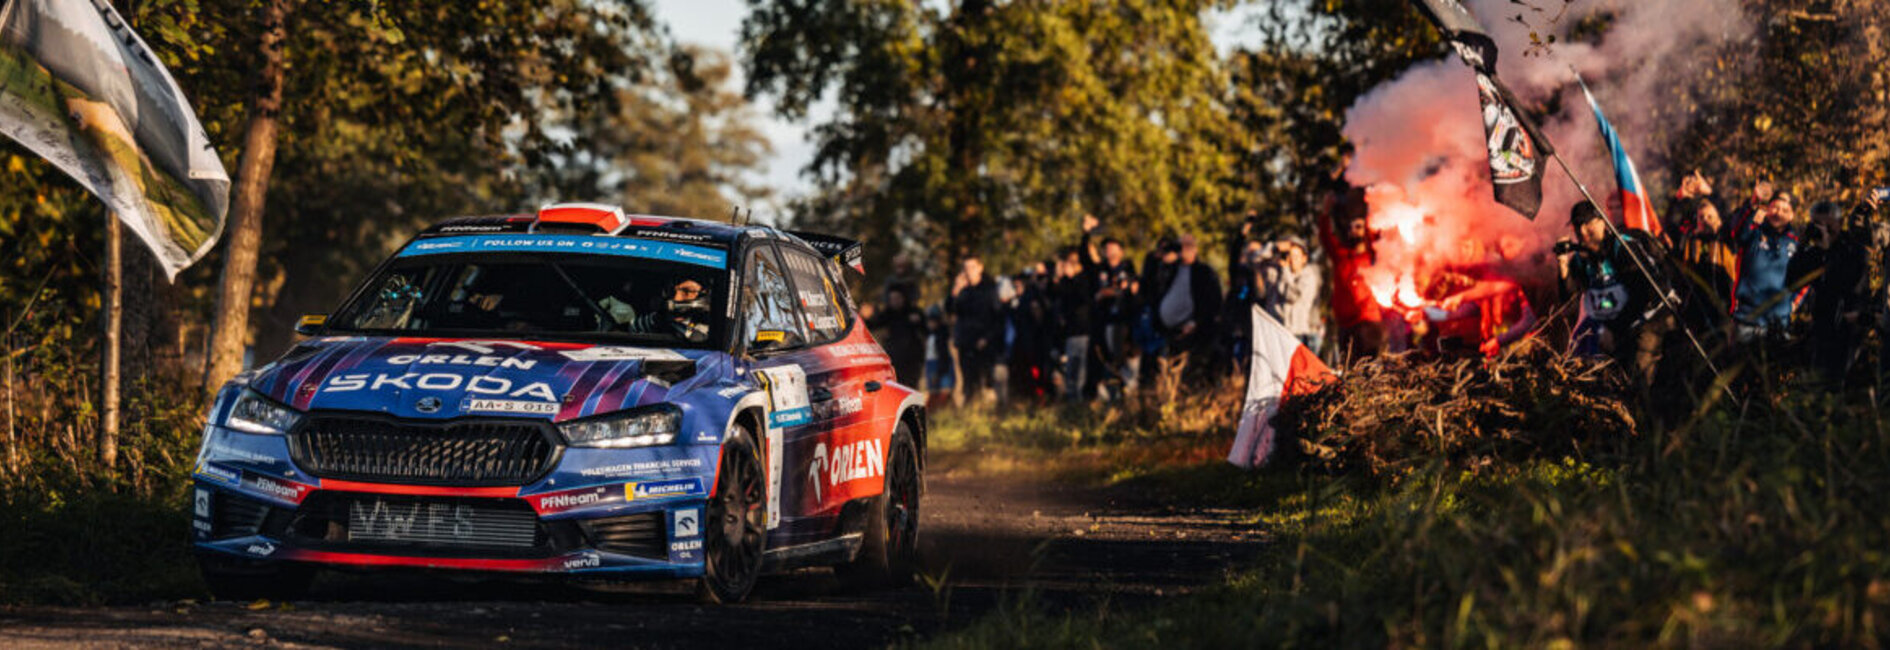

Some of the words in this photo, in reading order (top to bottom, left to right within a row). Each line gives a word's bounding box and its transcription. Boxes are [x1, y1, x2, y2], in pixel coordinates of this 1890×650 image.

[386, 354, 538, 370] ORLEN
[474, 401, 494, 409] AA
[504, 402, 514, 410] S
[523, 403, 554, 412] 015
[581, 464, 632, 477] VOLKSWAGEN
[633, 460, 671, 471] FINANCIAL
[671, 459, 701, 468] SERVICES
[830, 438, 884, 486] ORLEN
[257, 477, 298, 498] PFNteam
[648, 483, 695, 494] MICHELIN
[541, 493, 599, 509] PFNteam
[671, 540, 702, 551] ORLEN
[564, 555, 600, 568] verva
